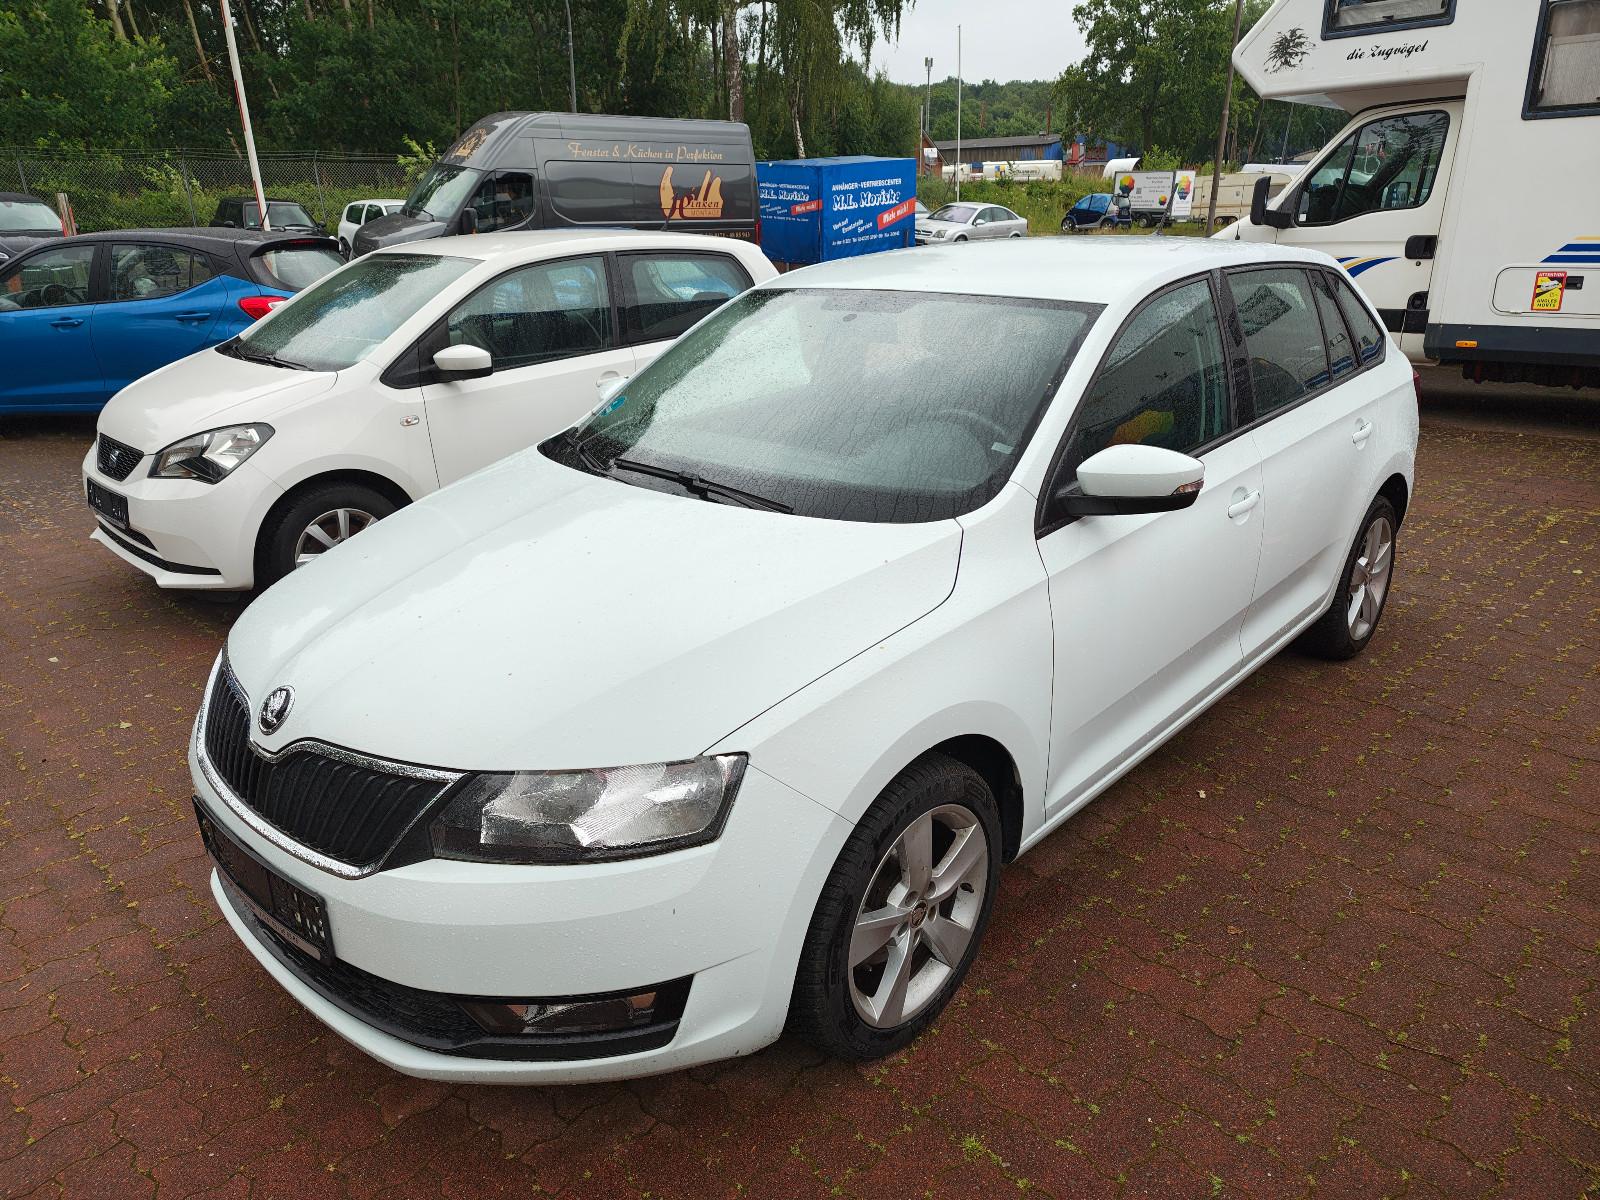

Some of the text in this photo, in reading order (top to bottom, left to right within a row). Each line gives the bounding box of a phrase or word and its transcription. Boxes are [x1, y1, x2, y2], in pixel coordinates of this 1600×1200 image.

[1347, 40, 1429, 61] die Zugvögel
[567, 142, 723, 163] Fenster & Küchen in Perfektion
[860, 188, 901, 207] Moriske
